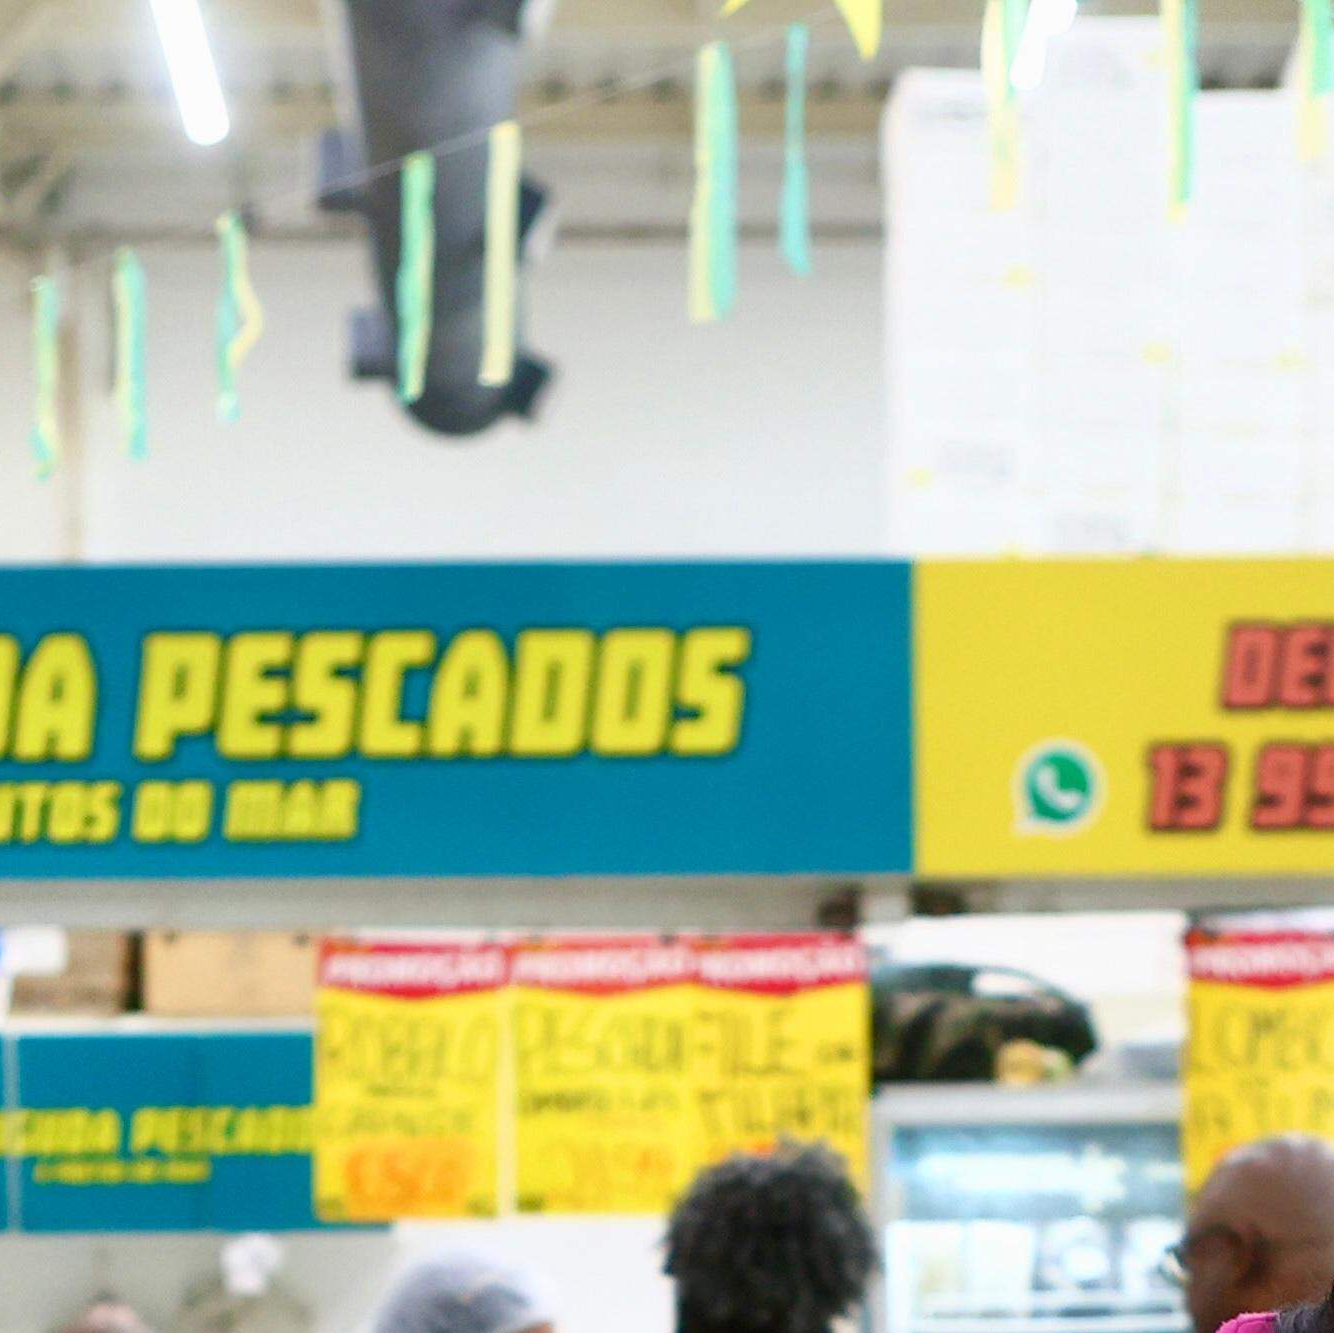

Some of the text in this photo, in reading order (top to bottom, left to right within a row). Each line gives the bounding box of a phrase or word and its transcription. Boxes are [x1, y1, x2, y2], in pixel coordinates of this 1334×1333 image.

[132, 627, 753, 762] PESCADOS
[131, 778, 214, 842] DO
[222, 778, 360, 841] MAR
[1149, 740, 1229, 831] 13
